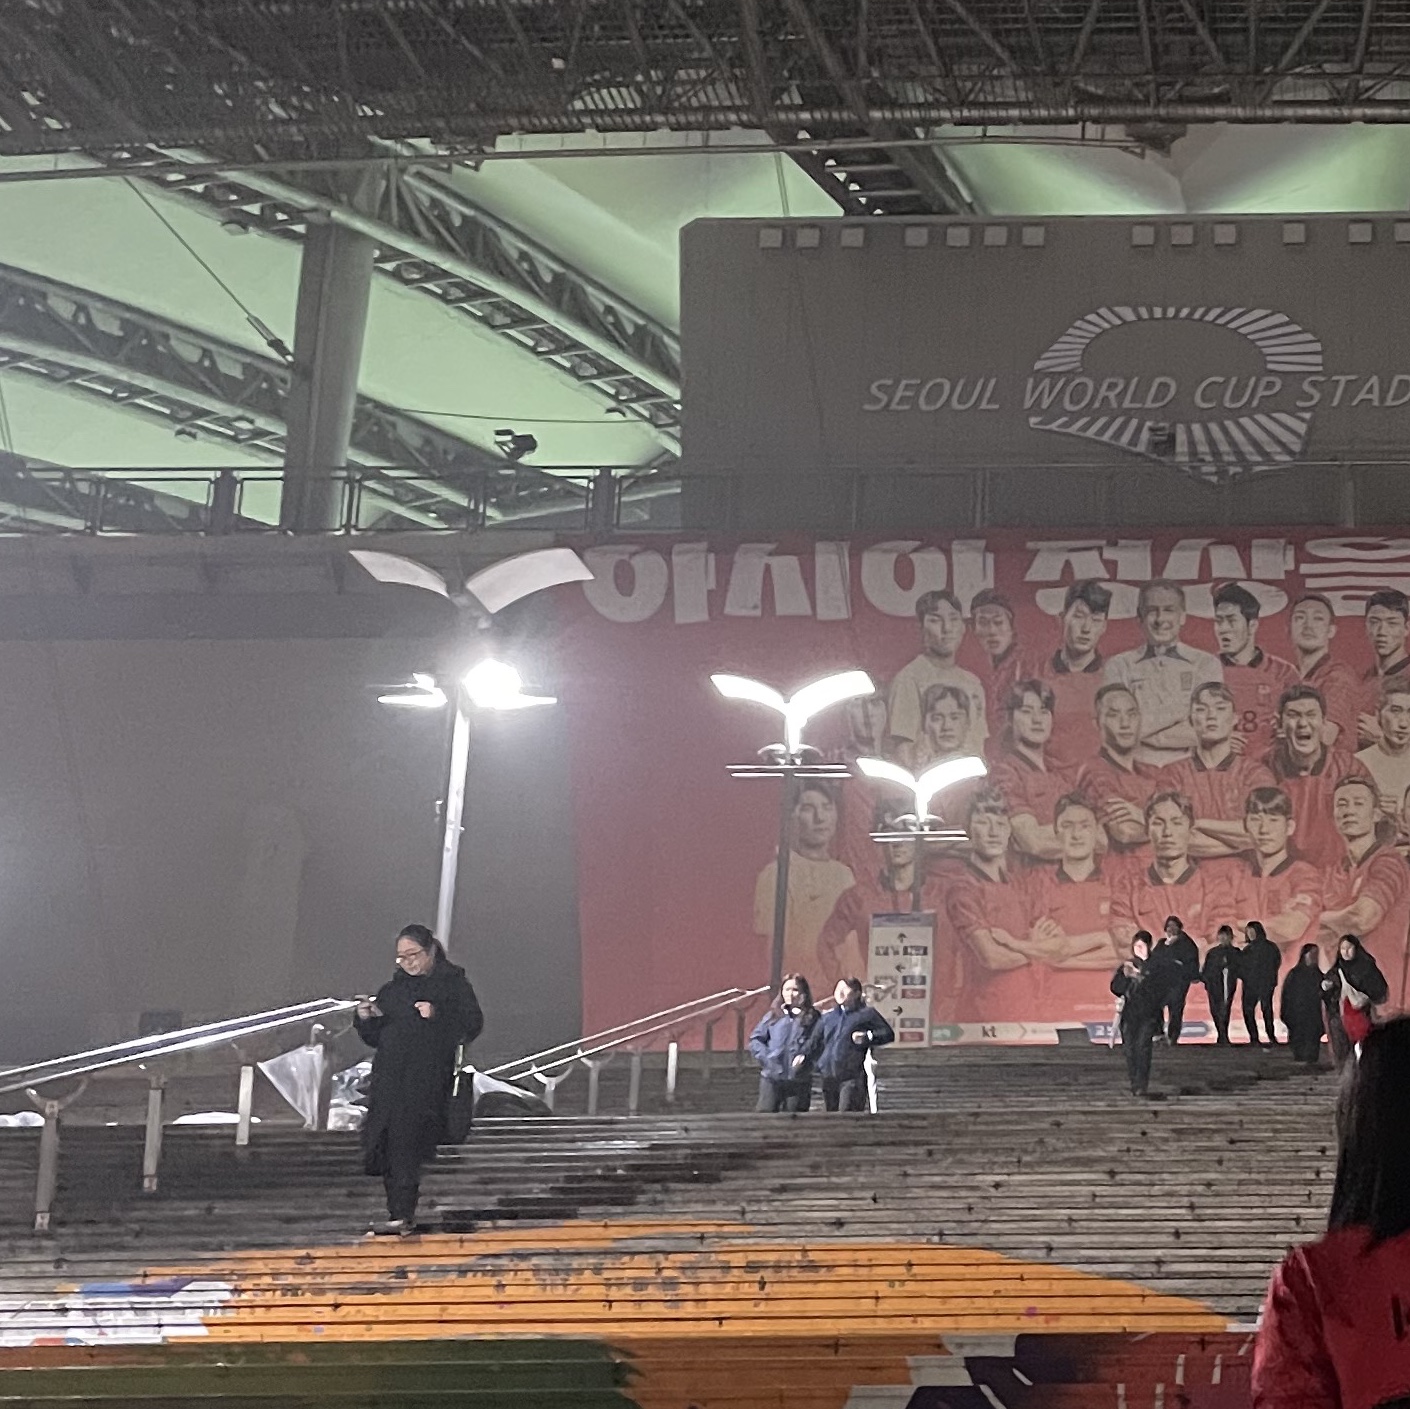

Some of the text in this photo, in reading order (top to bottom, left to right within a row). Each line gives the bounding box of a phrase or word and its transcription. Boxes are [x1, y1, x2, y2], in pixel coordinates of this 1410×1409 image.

[862, 376, 1000, 412] SEOUL
[1022, 374, 1177, 412] WORLD
[1194, 375, 1283, 409] CUP
[581, 539, 995, 625] 아시아
[981, 1025, 997, 1038] kt
